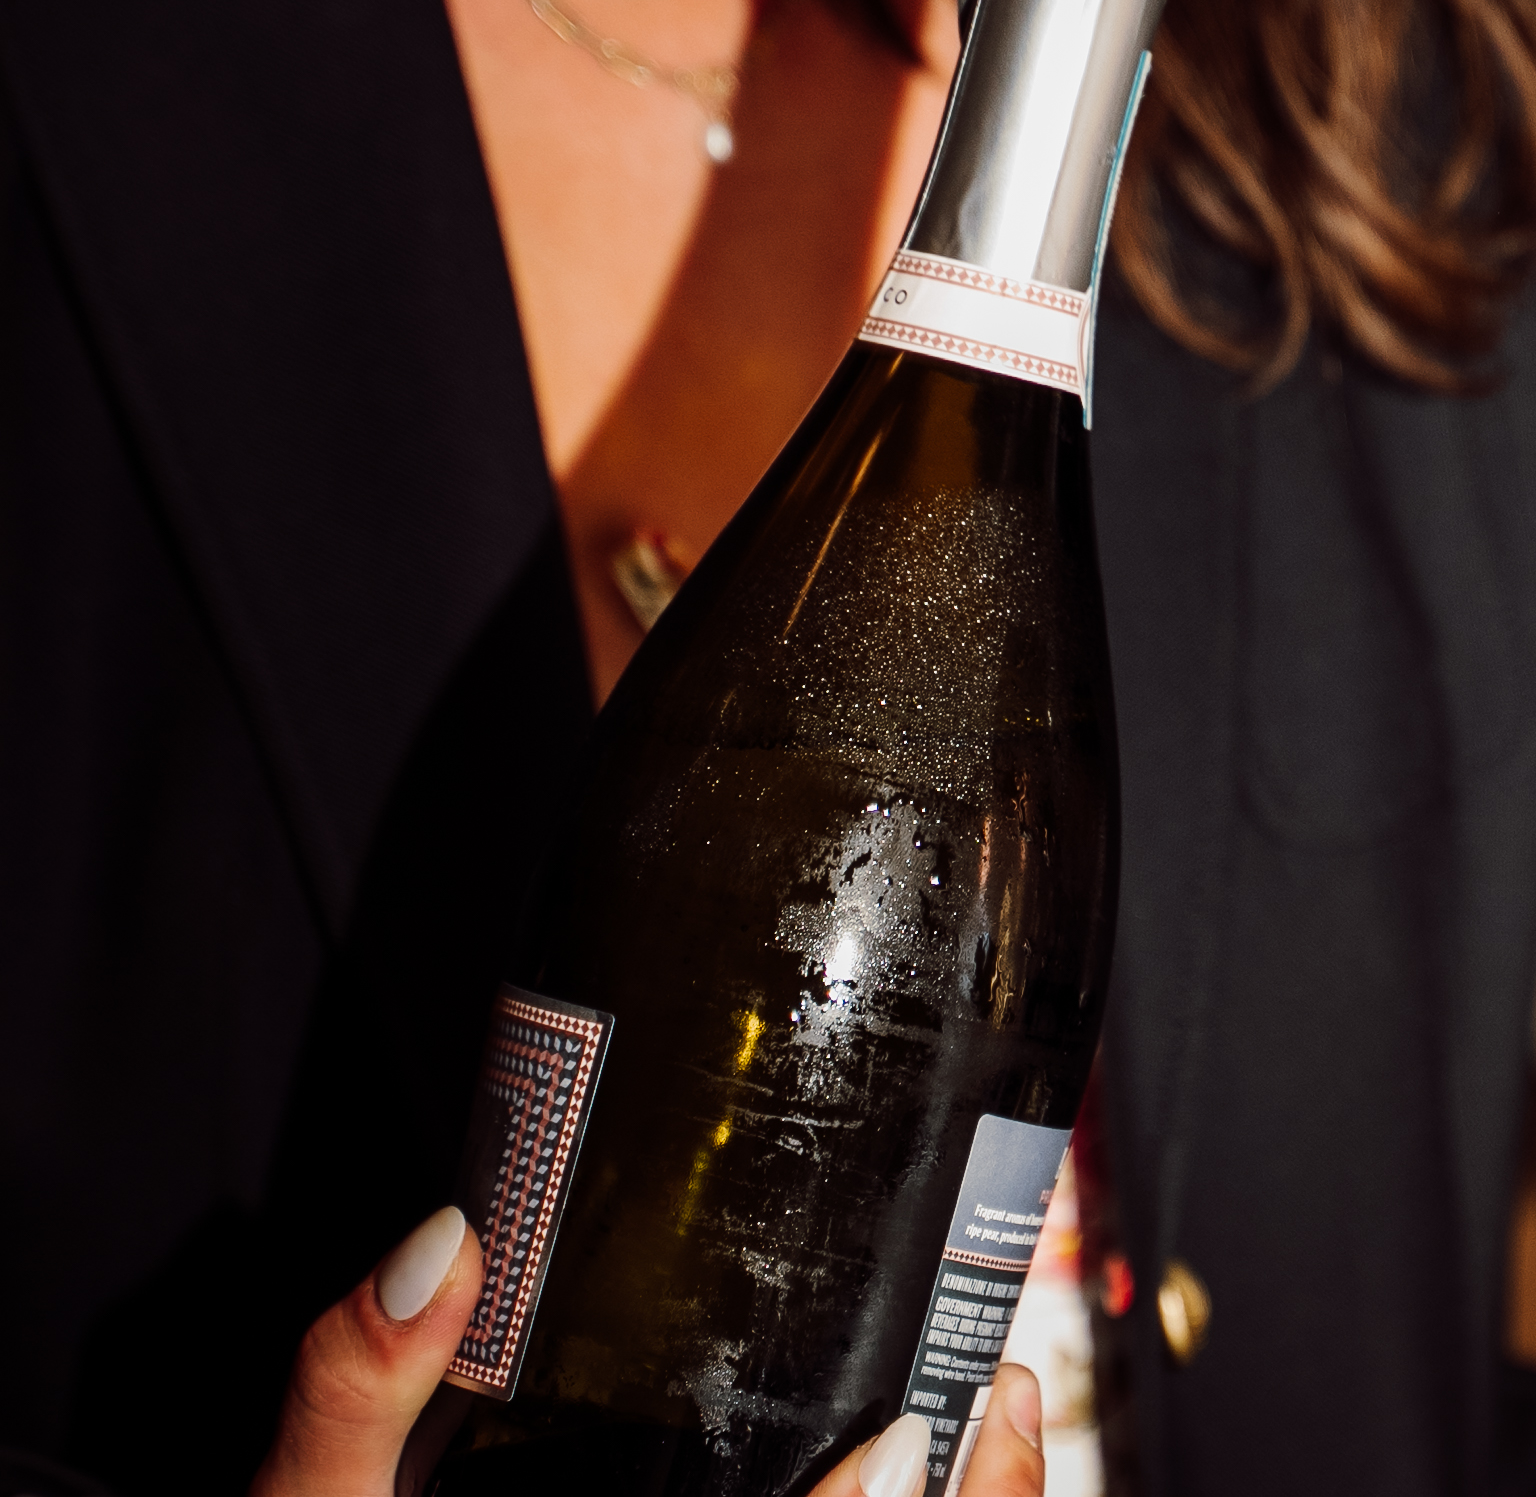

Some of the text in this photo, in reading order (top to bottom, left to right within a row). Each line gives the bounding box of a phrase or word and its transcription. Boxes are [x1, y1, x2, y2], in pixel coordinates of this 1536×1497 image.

[974, 1204, 1006, 1222] Fragrant
[965, 1223, 982, 1240] ripe
[981, 1228, 1000, 1243] pear,
[935, 1296, 983, 1318] GOVERNMENT
[910, 1390, 939, 1409] IMPORTED
